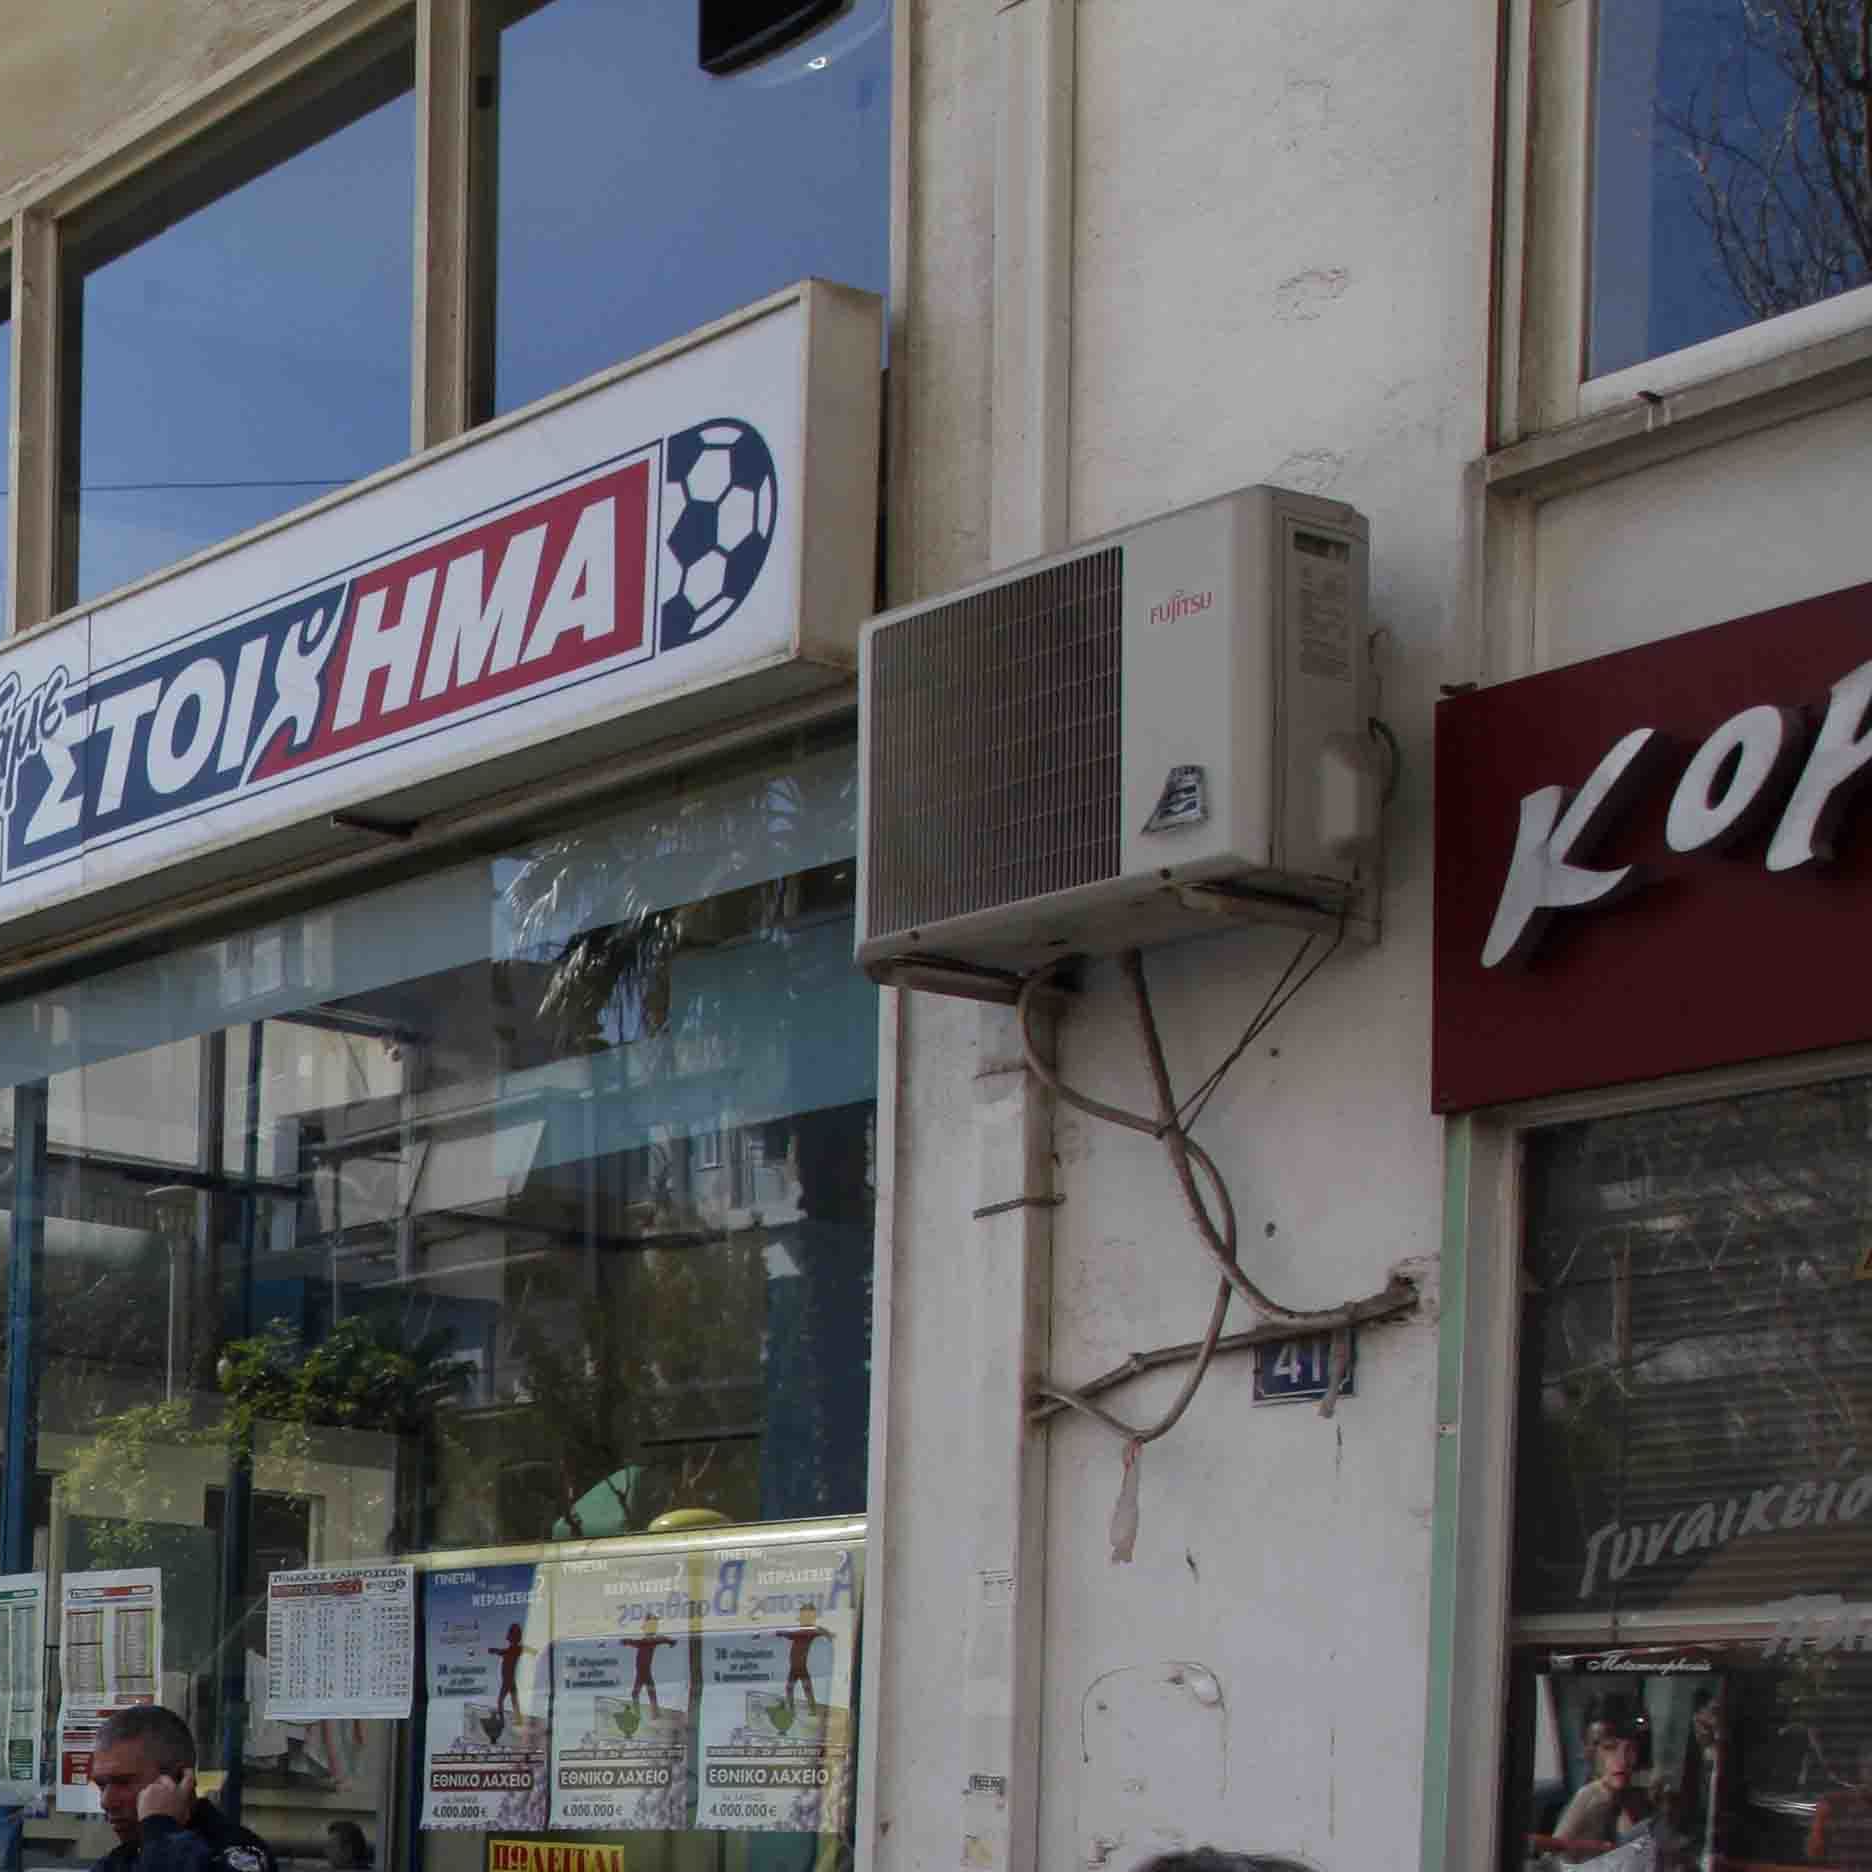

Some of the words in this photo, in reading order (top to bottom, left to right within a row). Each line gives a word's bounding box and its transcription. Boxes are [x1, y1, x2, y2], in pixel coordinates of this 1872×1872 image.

[1150, 588, 1216, 625] FUJITSU
[23, 495, 617, 847] ΣΤΟΙΧΗΜΑ
[432, 1773, 480, 1788] ΕΘΝΙΚΟ
[482, 1772, 531, 1788] ΛΑΧΕΙΟ
[560, 1769, 614, 1786] ΕΘΝΙΚΟ
[616, 1768, 669, 1785] ΛΑΧΕΙΟ
[709, 1768, 767, 1785] ΕΘΝΙΚΟ
[769, 1767, 829, 1785] ΛΑΧΕΙΟ
